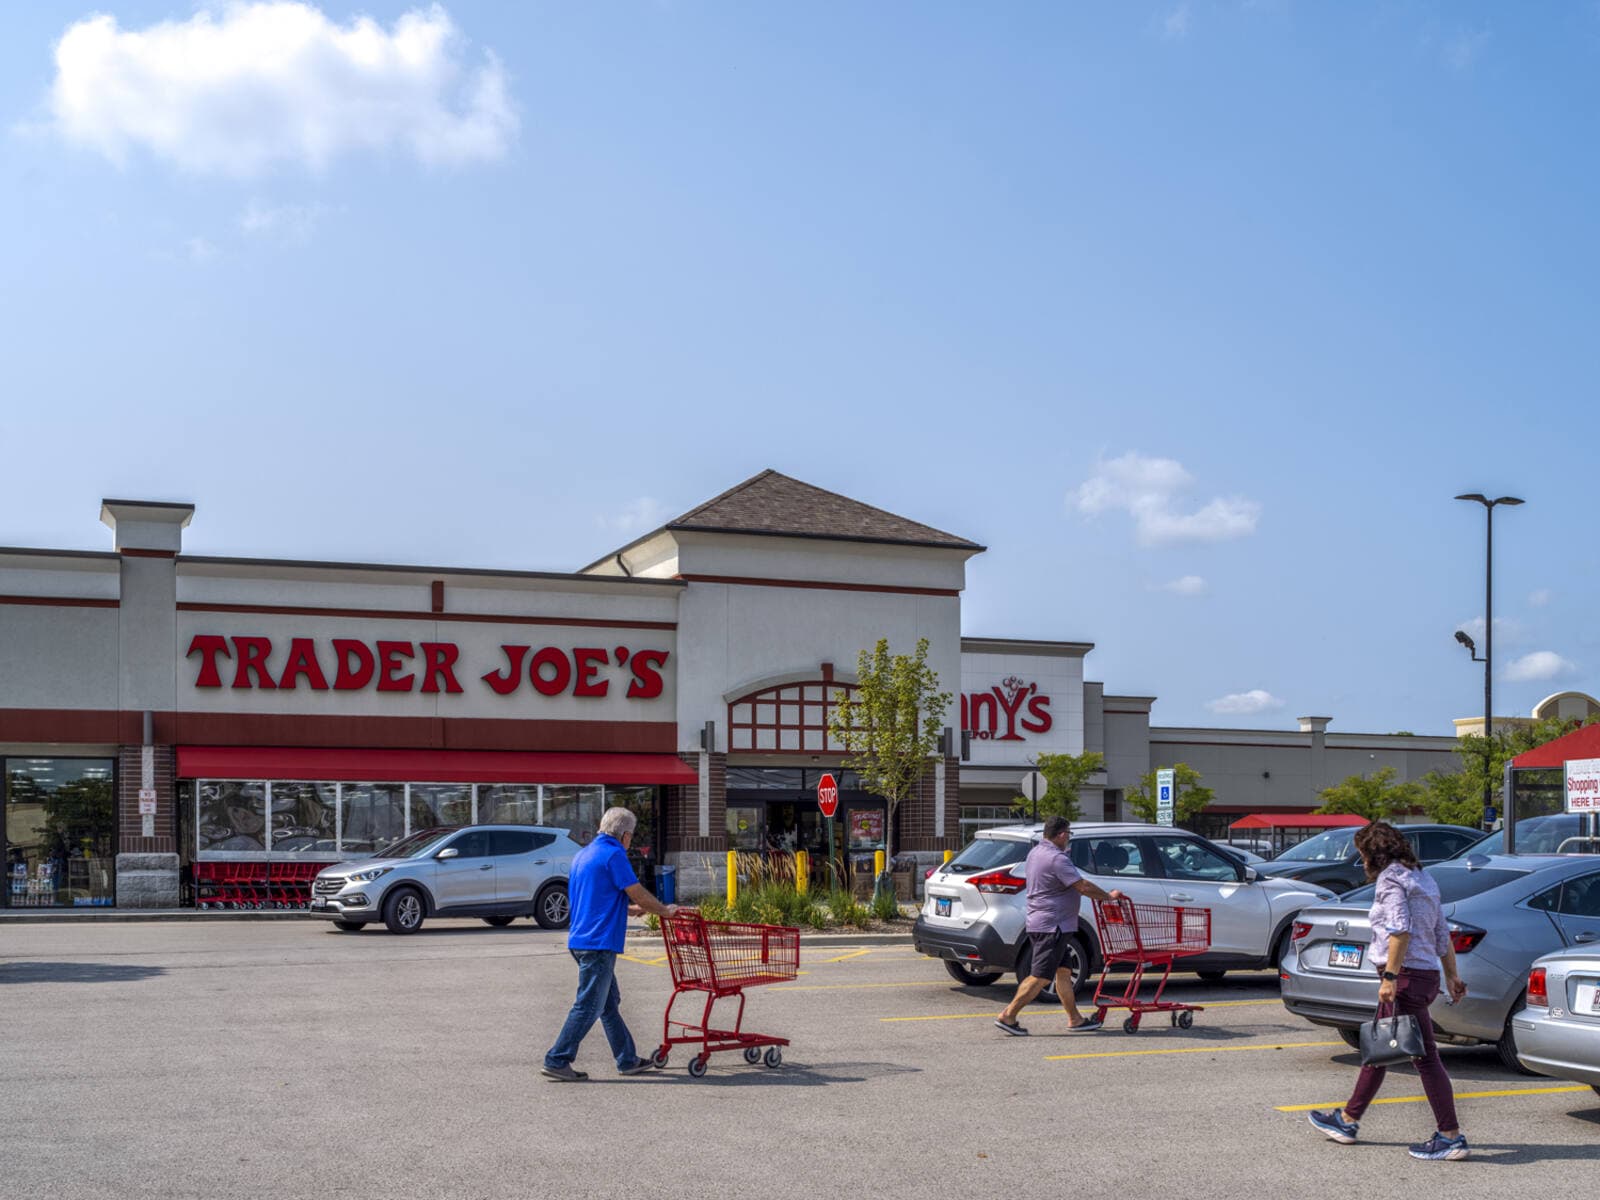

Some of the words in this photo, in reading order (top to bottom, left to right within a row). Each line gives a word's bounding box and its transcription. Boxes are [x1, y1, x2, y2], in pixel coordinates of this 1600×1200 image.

[186, 634, 464, 692] TRADER
[480, 645, 670, 698] JOE'S
[1568, 776, 1598, 794] Shopping
[820, 787, 836, 803] STOP
[1571, 797, 1590, 807] HERE
